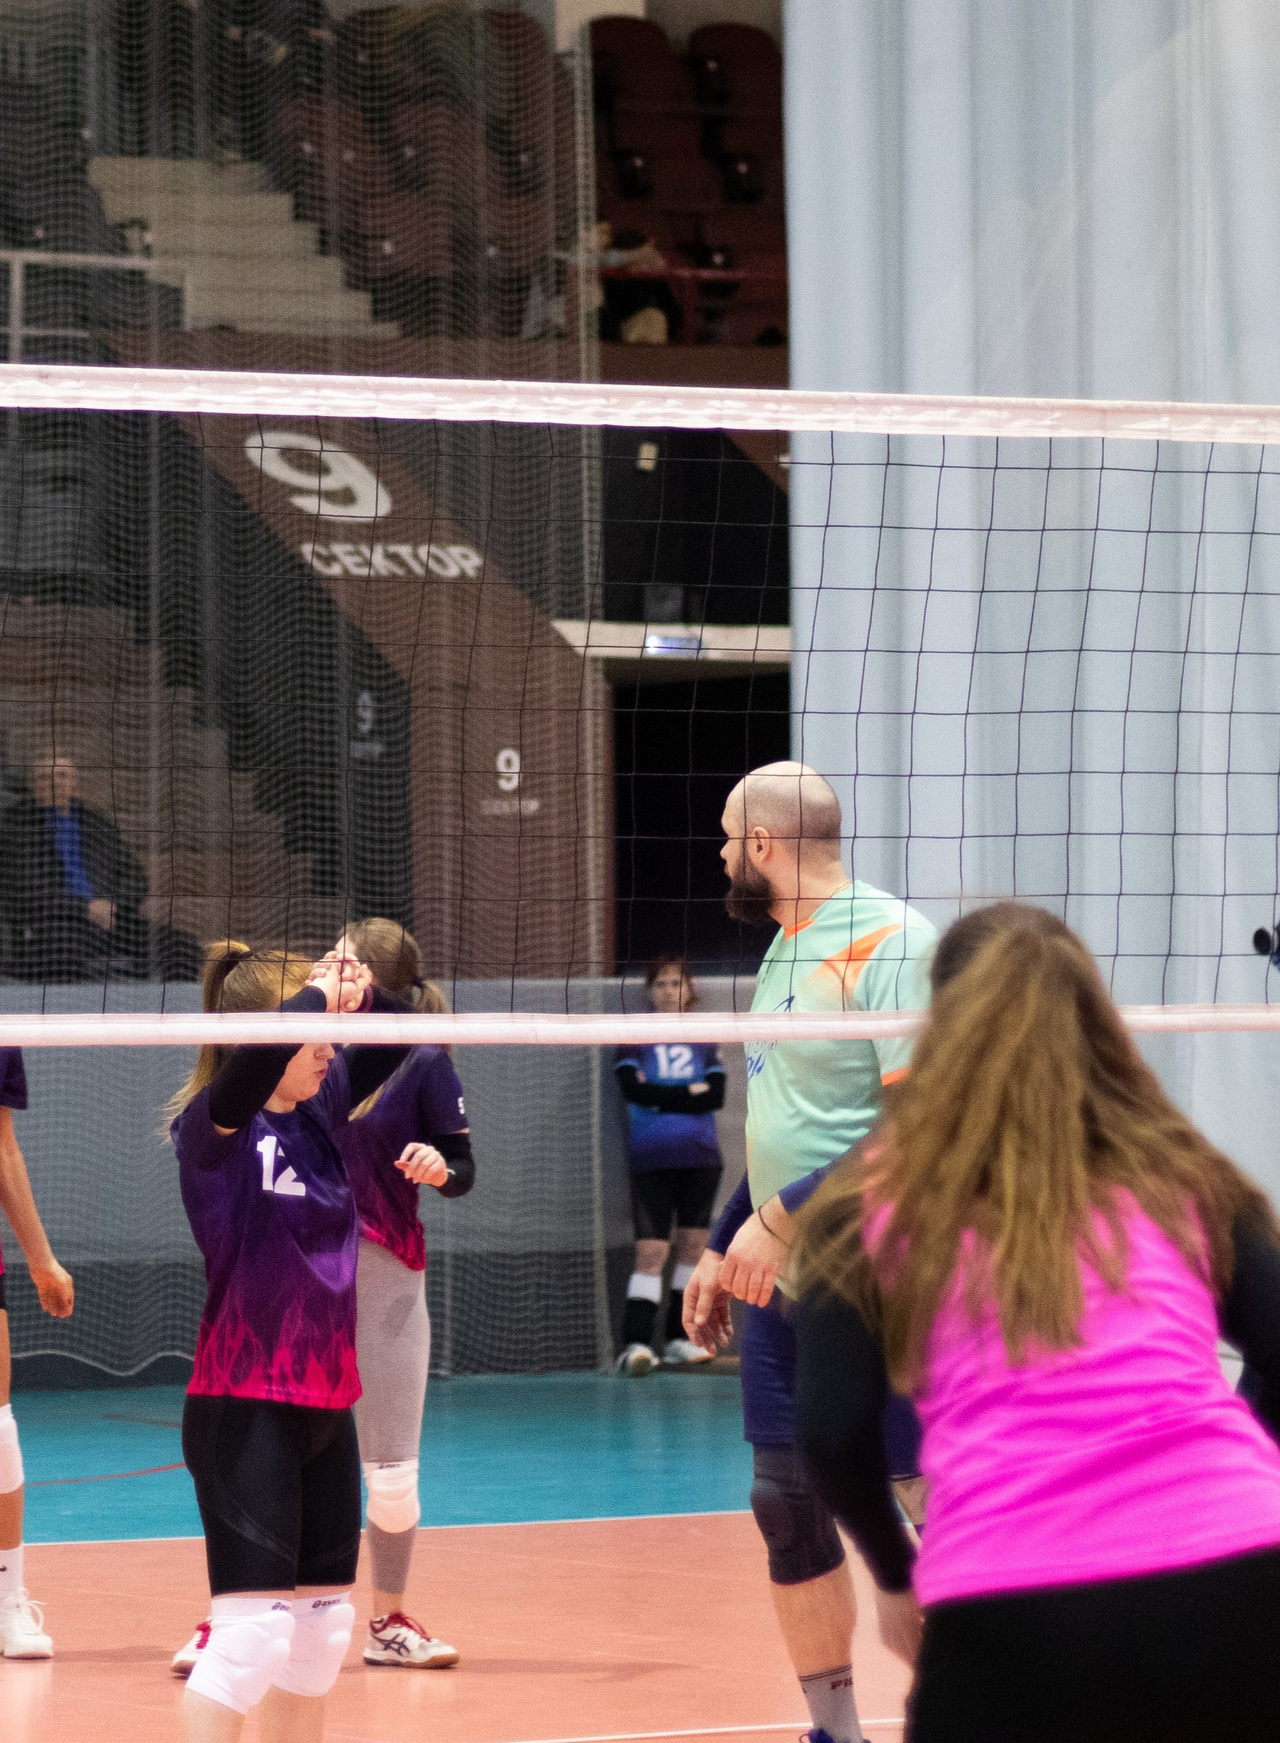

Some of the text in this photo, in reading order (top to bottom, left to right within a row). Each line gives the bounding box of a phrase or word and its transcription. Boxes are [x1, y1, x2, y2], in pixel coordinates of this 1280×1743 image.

[244, 431, 392, 522] 9
[300, 542, 485, 578] СЕКТОР
[495, 747, 521, 792] 9
[654, 1044, 694, 1078] 12
[256, 1135, 306, 1197] 12
